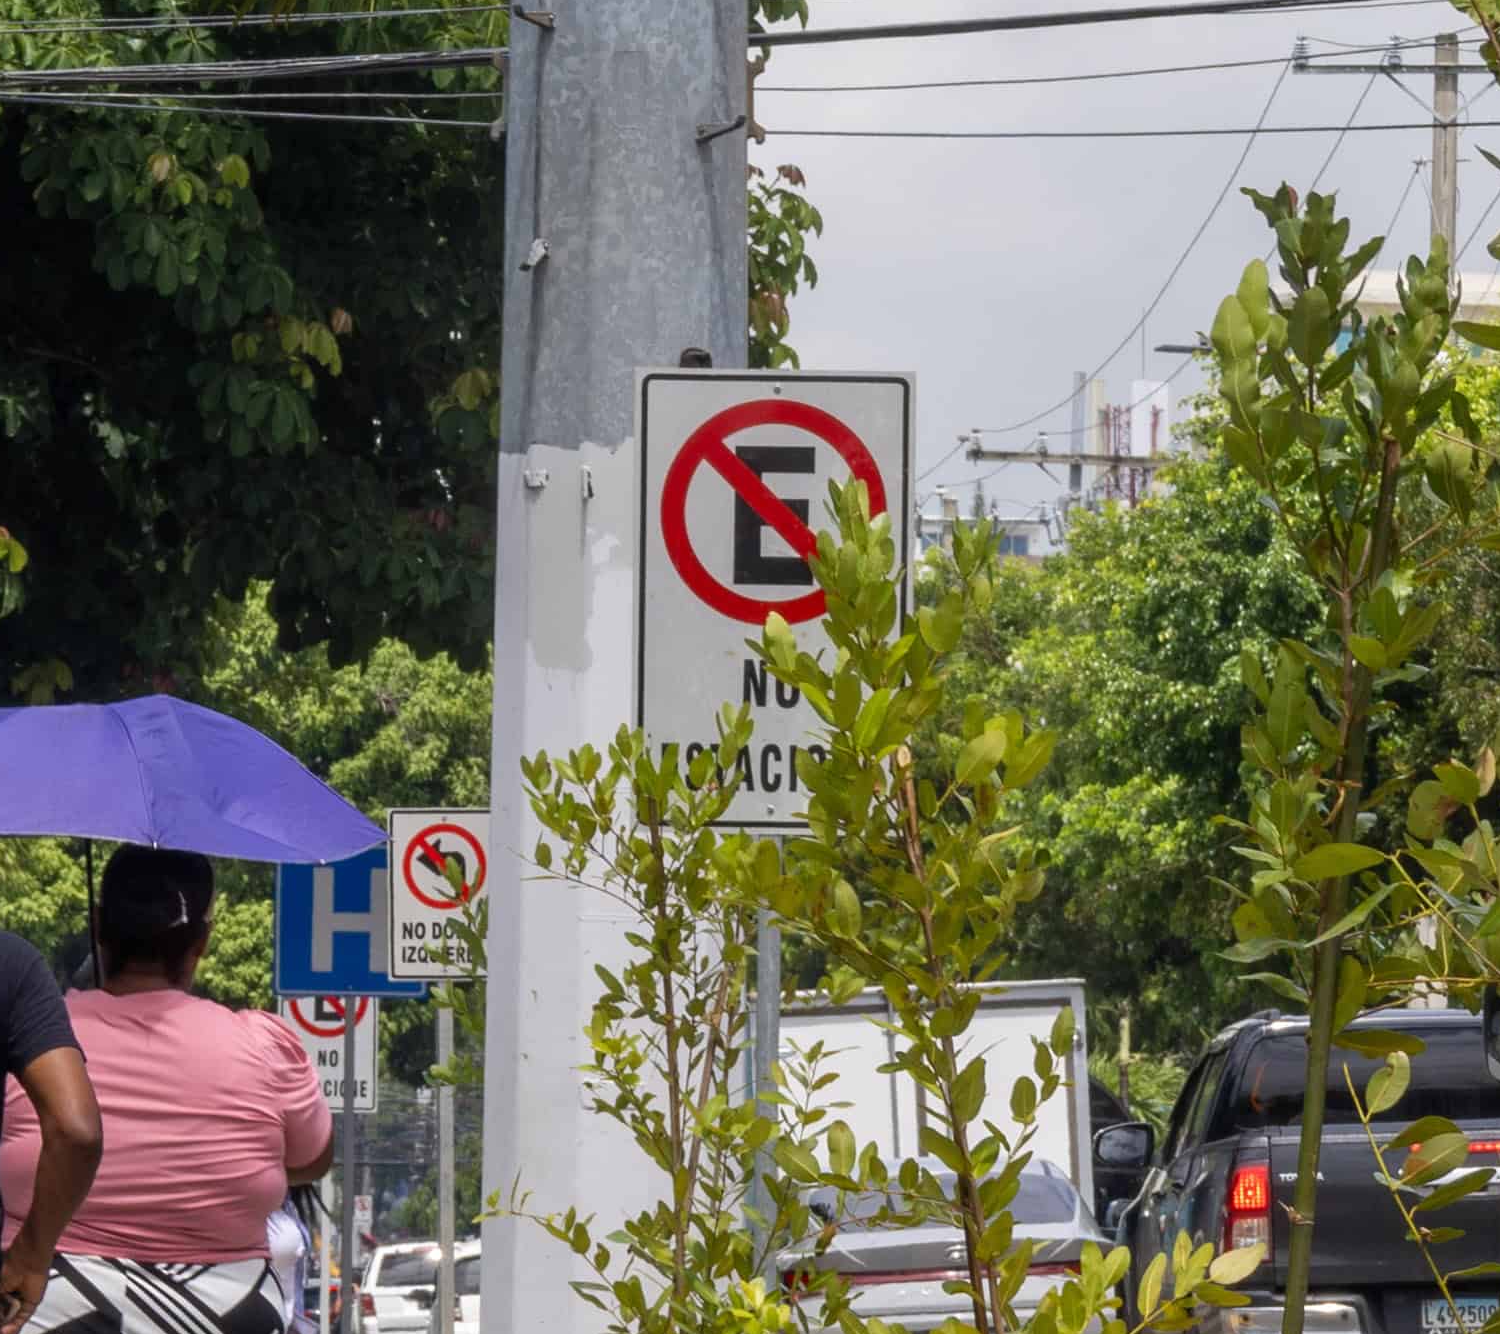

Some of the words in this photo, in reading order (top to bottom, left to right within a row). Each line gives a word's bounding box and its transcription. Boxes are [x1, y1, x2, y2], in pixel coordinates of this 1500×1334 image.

[311, 867, 389, 973] H
[402, 922, 426, 940] NO
[317, 1050, 339, 1068] NO
